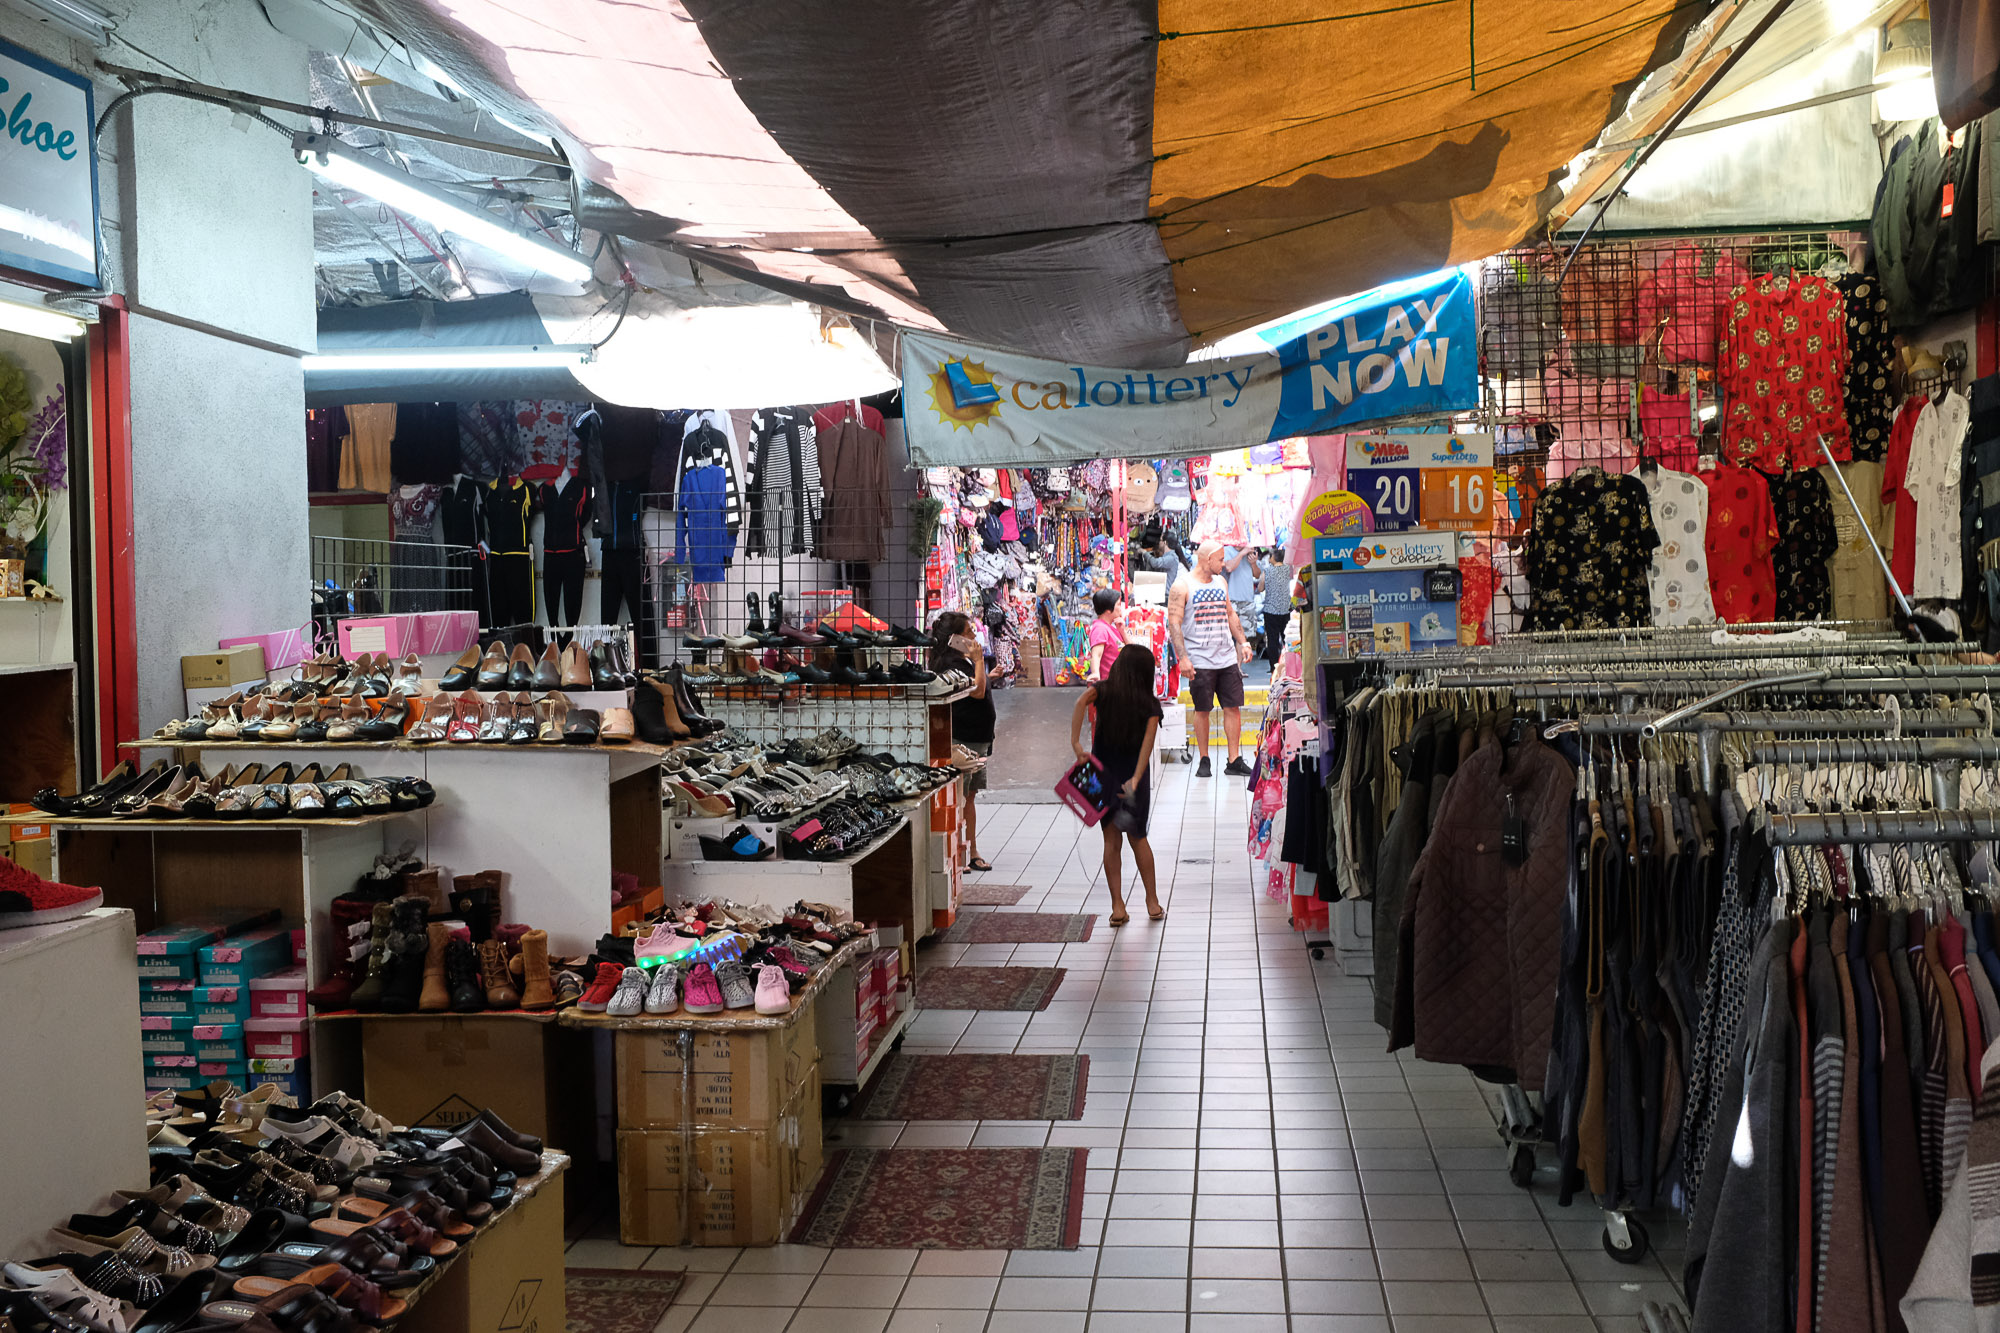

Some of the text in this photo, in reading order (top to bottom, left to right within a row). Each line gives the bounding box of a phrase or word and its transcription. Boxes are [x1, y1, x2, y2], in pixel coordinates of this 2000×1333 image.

[1306, 293, 1449, 361] PLAY
[1309, 337, 1450, 411] NOW
[1012, 364, 1255, 411] calottery
[1373, 443, 1409, 456] MEGA
[1370, 454, 1410, 466] MILLIONS
[1431, 452, 1479, 463] SuperLotto
[1375, 475, 1411, 515] 20
[1449, 474, 1484, 514] 16
[1330, 510, 1339, 519] 25
[1340, 502, 1362, 515] YEARS
[1375, 520, 1400, 530] LLION
[1438, 520, 1474, 529] MILLION
[1322, 547, 1354, 559] PLAY
[1390, 543, 1444, 555] calottery
[1385, 604, 1397, 612] FOR
[1400, 602, 1432, 611] MILLIONS
[144, 958, 171, 966] Link
[262, 1074, 285, 1082] Link
[715, 1096, 732, 1105] ITEM
[695, 1107, 732, 1115] FOOTWEAR
